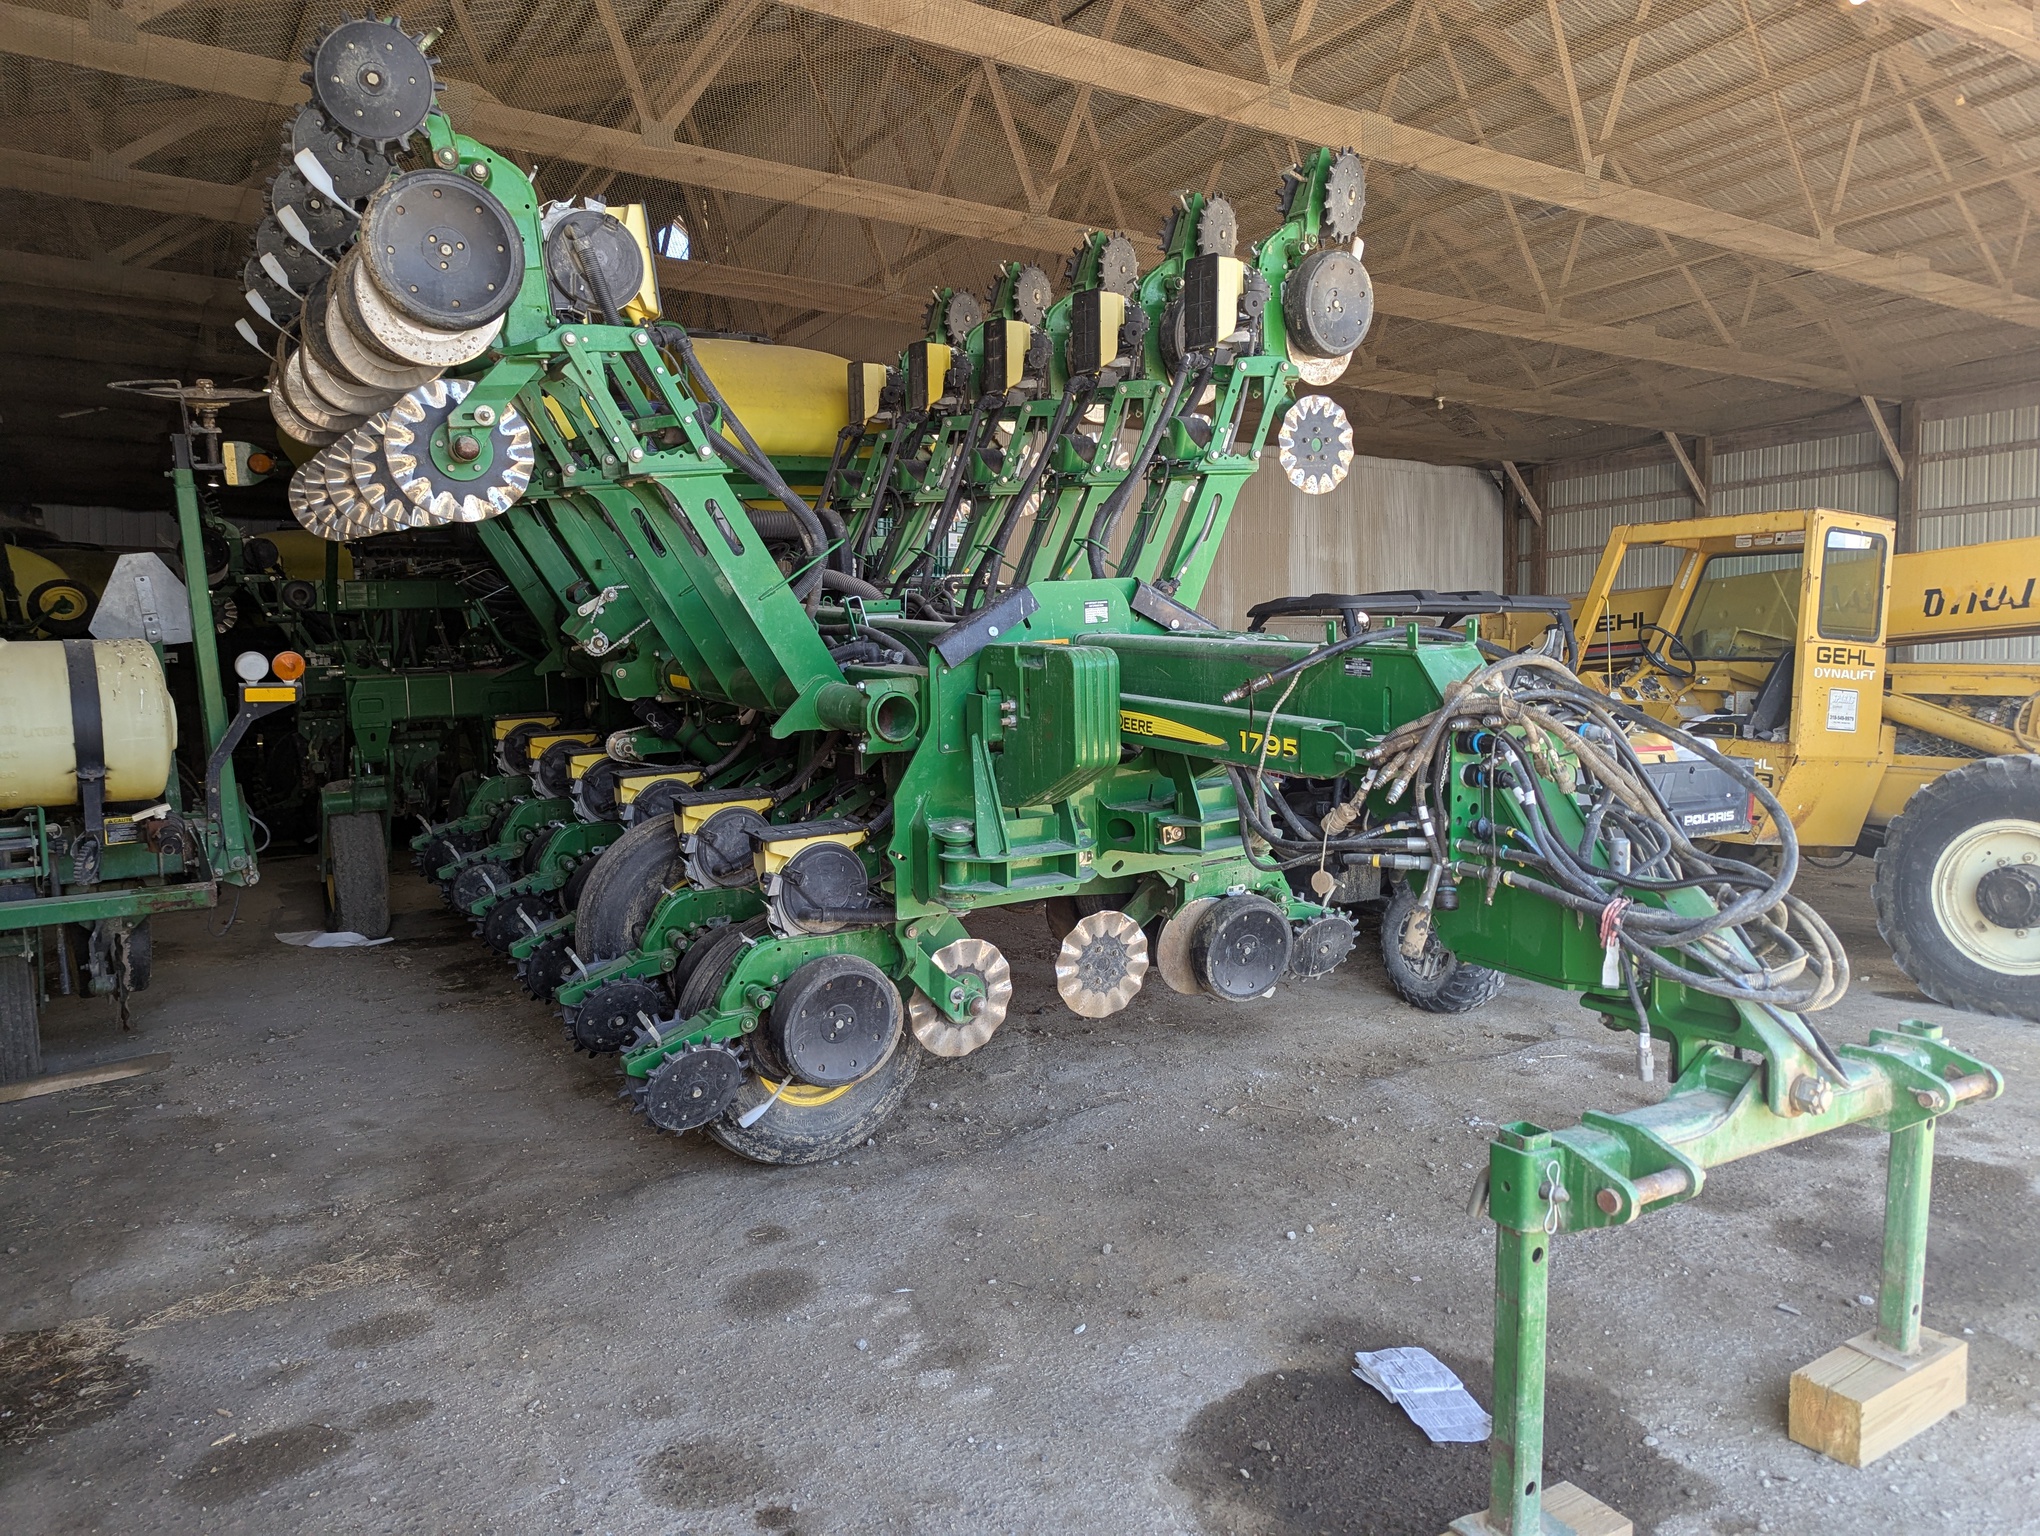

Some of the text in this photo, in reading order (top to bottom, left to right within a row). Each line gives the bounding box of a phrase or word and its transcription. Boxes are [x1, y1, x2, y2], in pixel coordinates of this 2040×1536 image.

[1816, 646, 1876, 667] GEHL
[1814, 667, 1877, 681] DYNALIFT
[1120, 713, 1154, 734] EERE
[1239, 731, 1298, 758] 1795
[1754, 758, 1774, 770] HL
[1684, 810, 1735, 827] POLARIS
